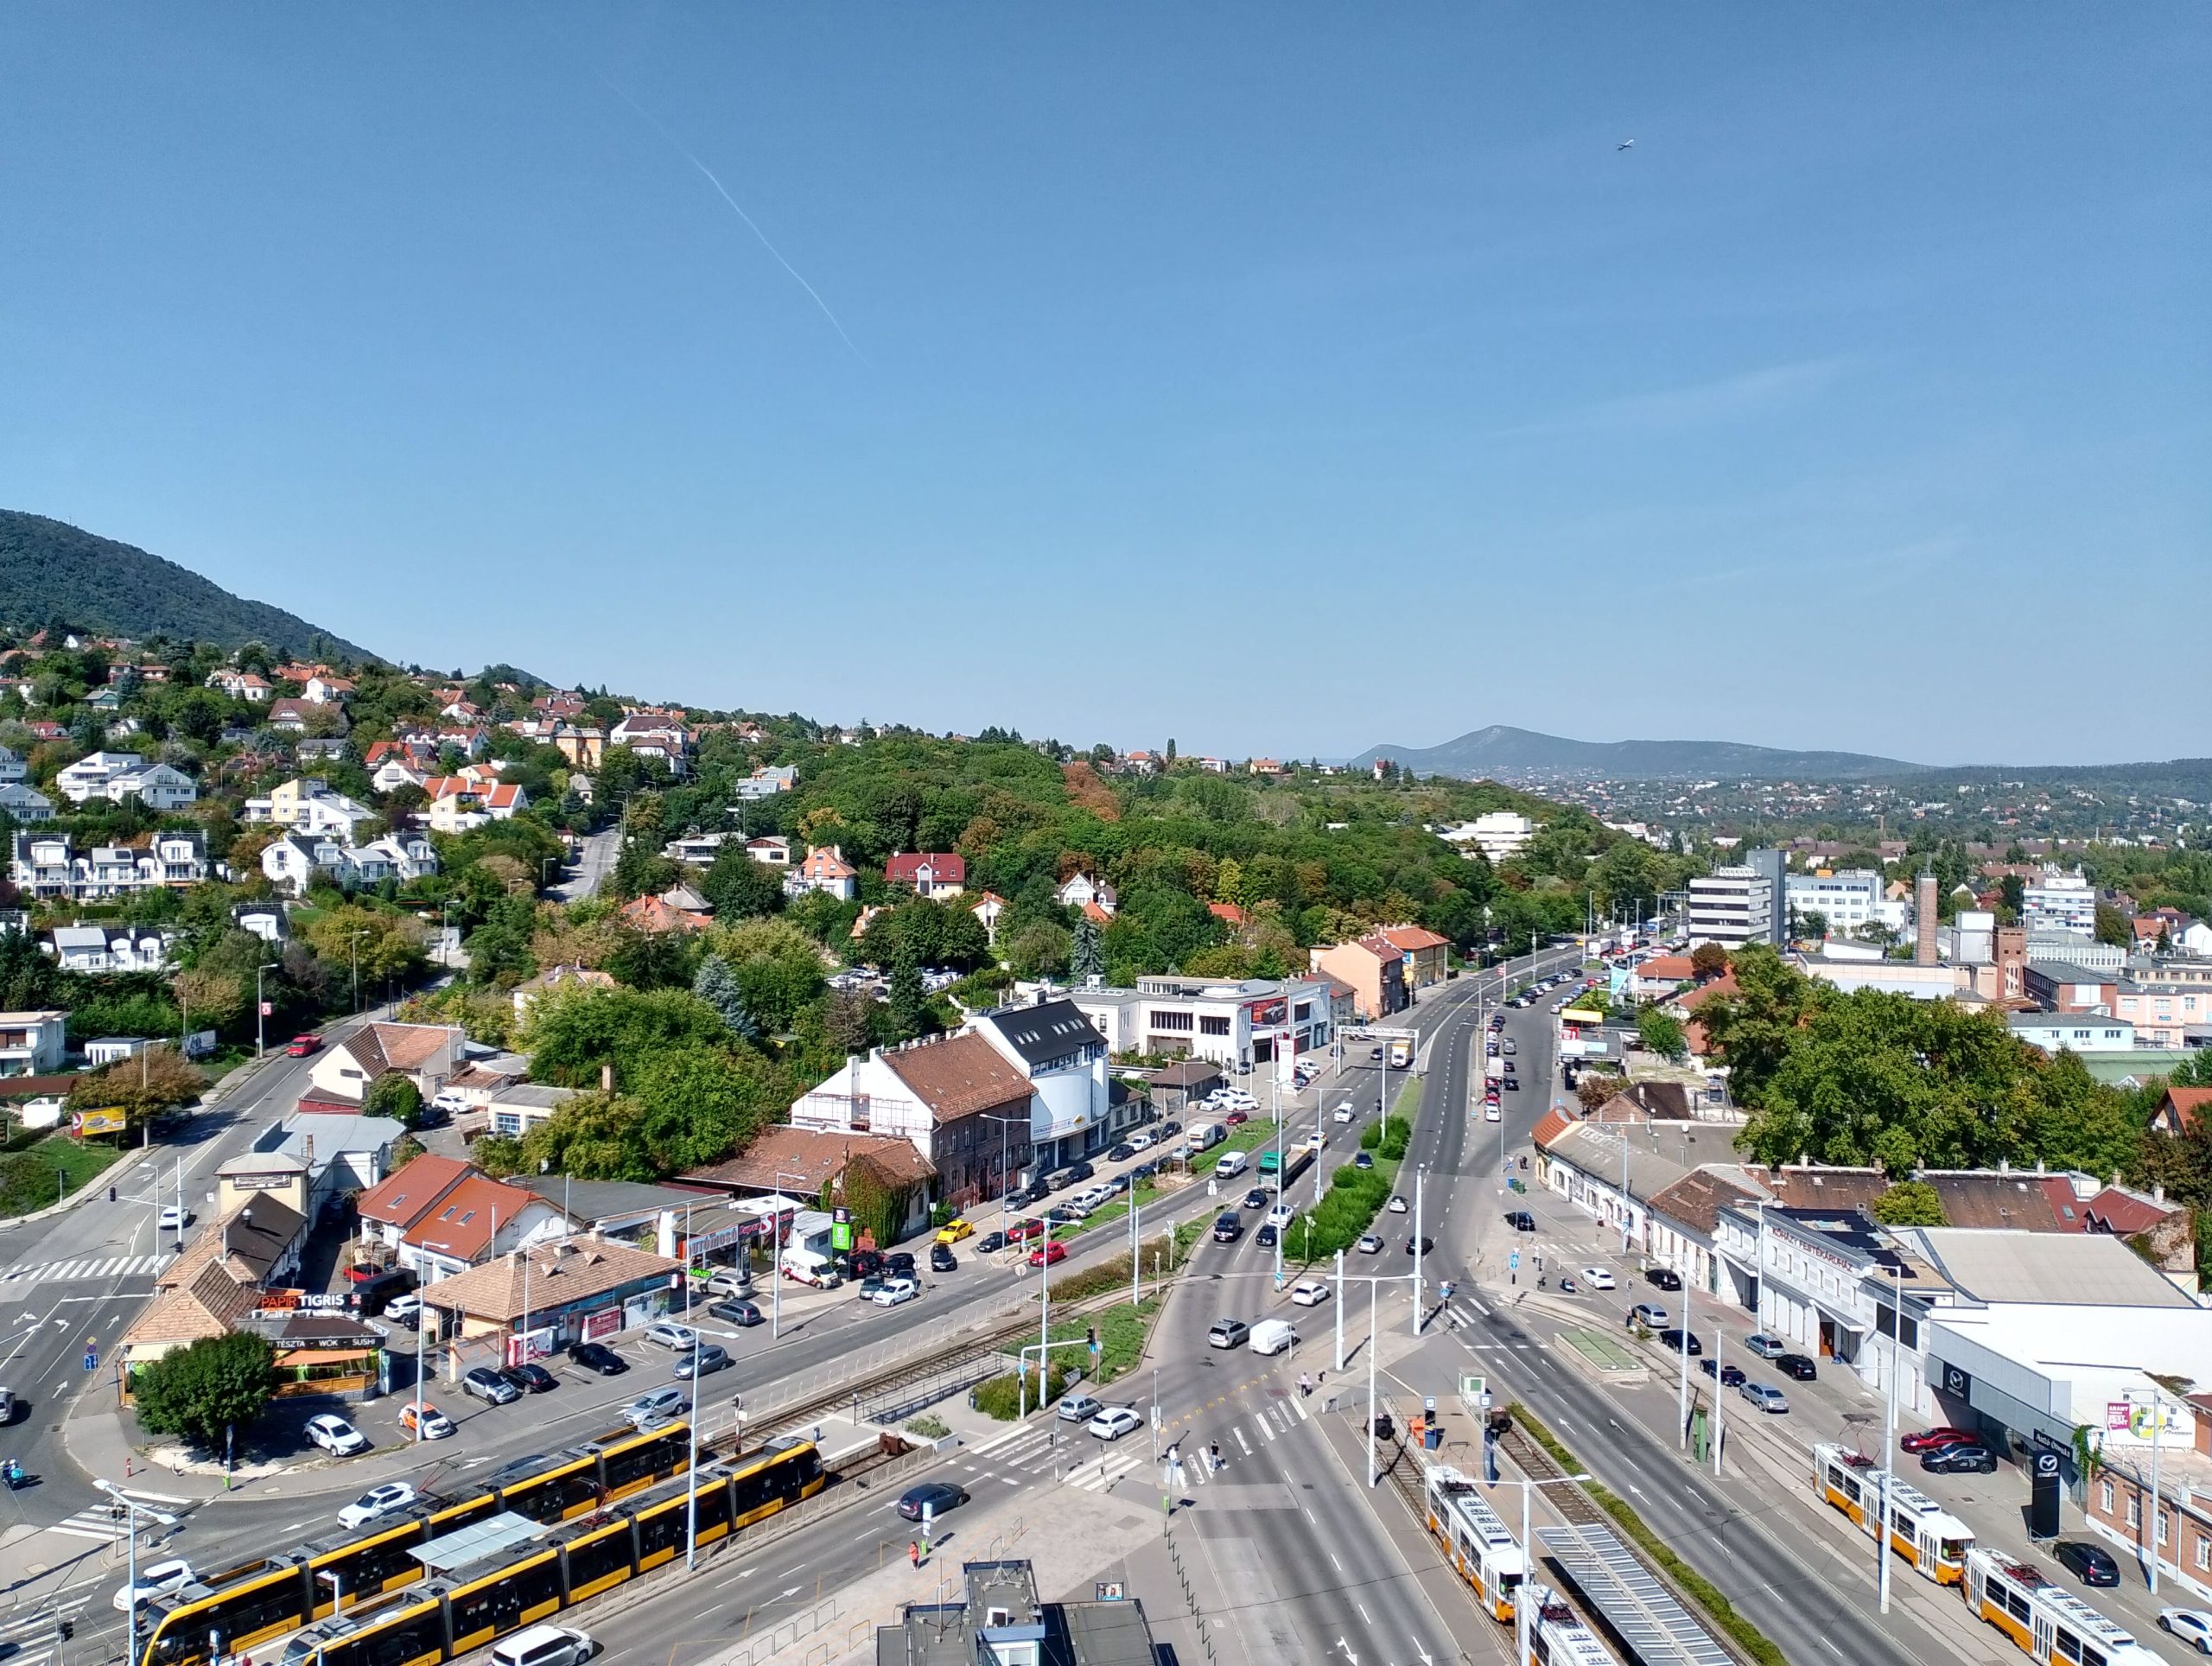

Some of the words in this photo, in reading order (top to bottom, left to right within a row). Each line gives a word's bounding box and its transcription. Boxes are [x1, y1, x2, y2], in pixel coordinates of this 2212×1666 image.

[298, 1294, 345, 1307] TIGRIS
[276, 1339, 306, 1348] TÉSZTA
[352, 1338, 376, 1346] SUSHI
